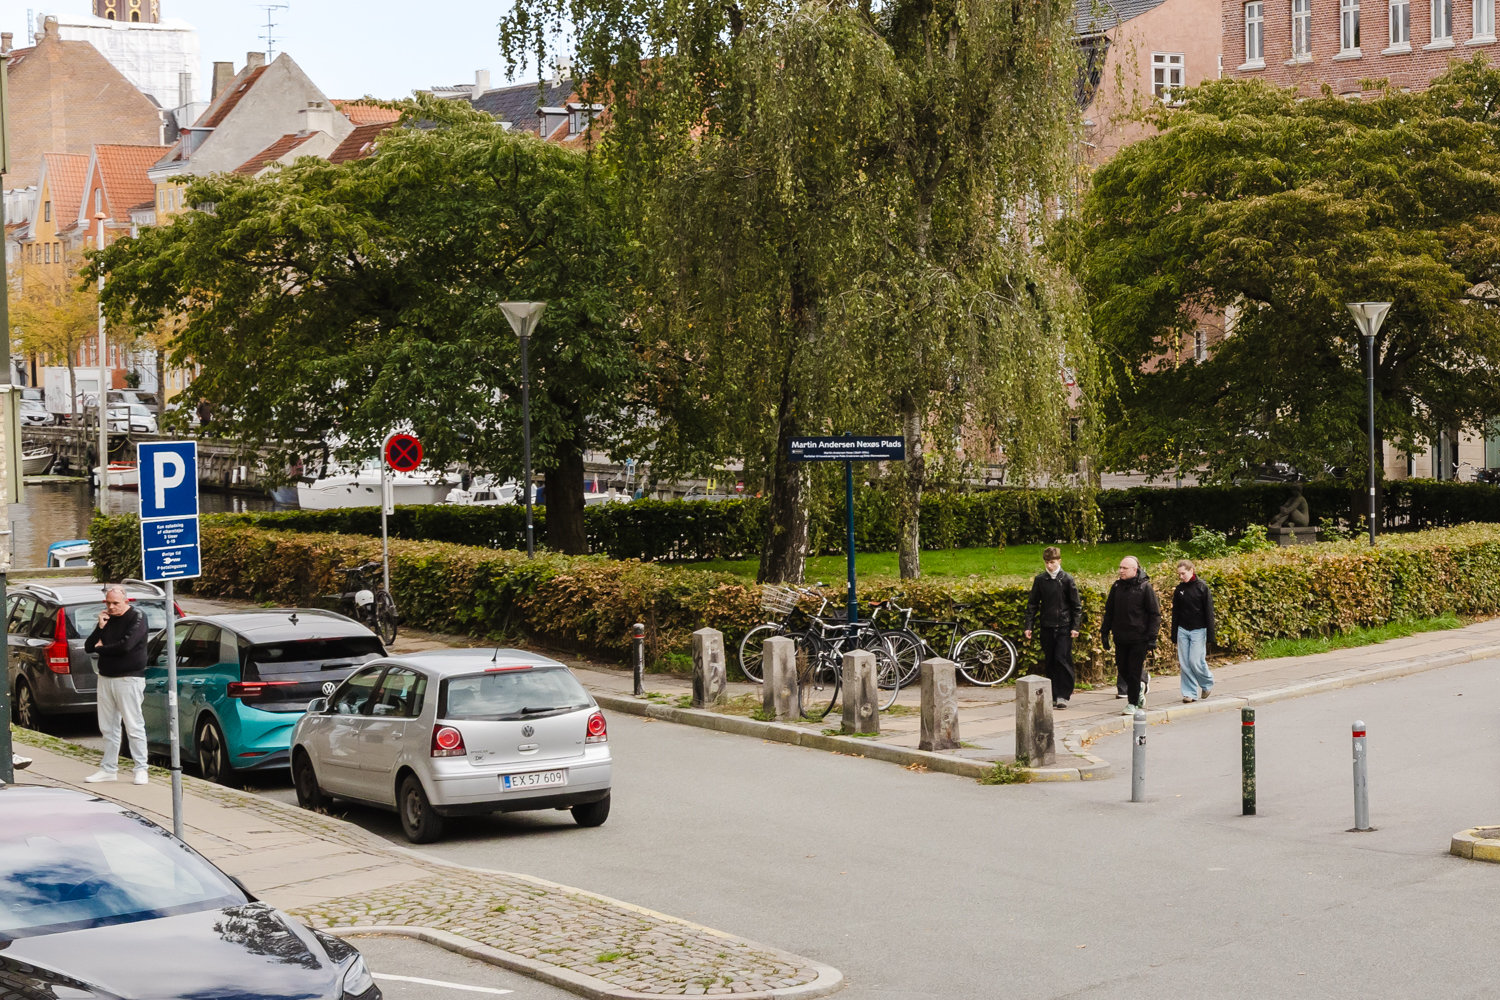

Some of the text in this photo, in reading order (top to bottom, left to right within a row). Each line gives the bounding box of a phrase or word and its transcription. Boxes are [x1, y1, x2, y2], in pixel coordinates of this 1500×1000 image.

[153, 451, 185, 509] P
[512, 772, 561, 786] EX 57 609
